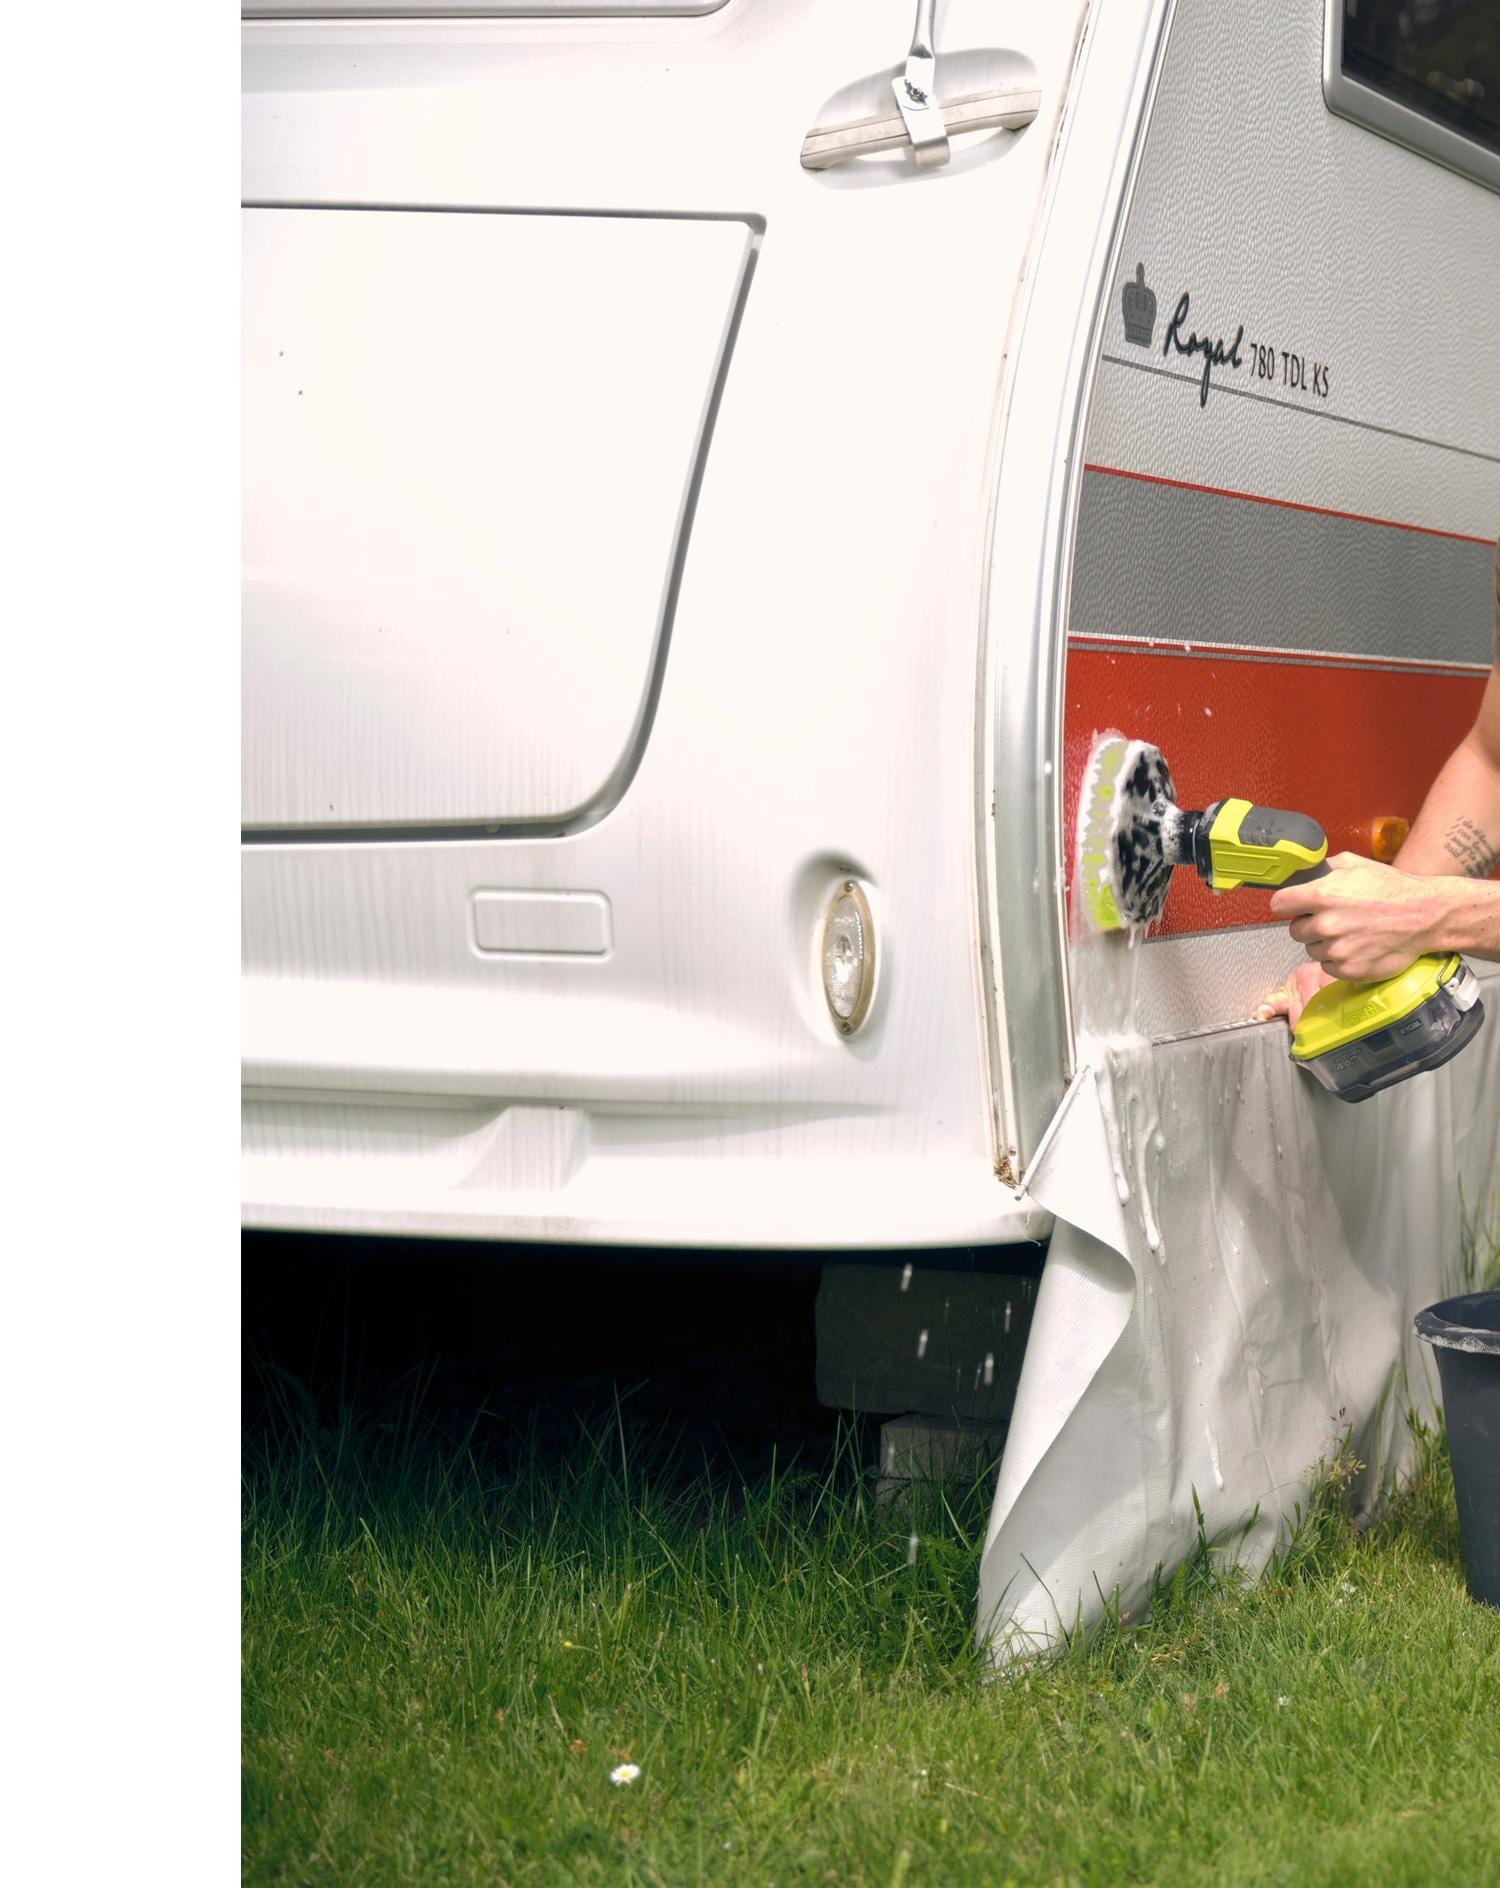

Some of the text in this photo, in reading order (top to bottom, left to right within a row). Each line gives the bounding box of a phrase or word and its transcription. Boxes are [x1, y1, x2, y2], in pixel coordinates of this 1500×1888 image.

[1163, 291, 1330, 409] Royal 780 TDL KS
